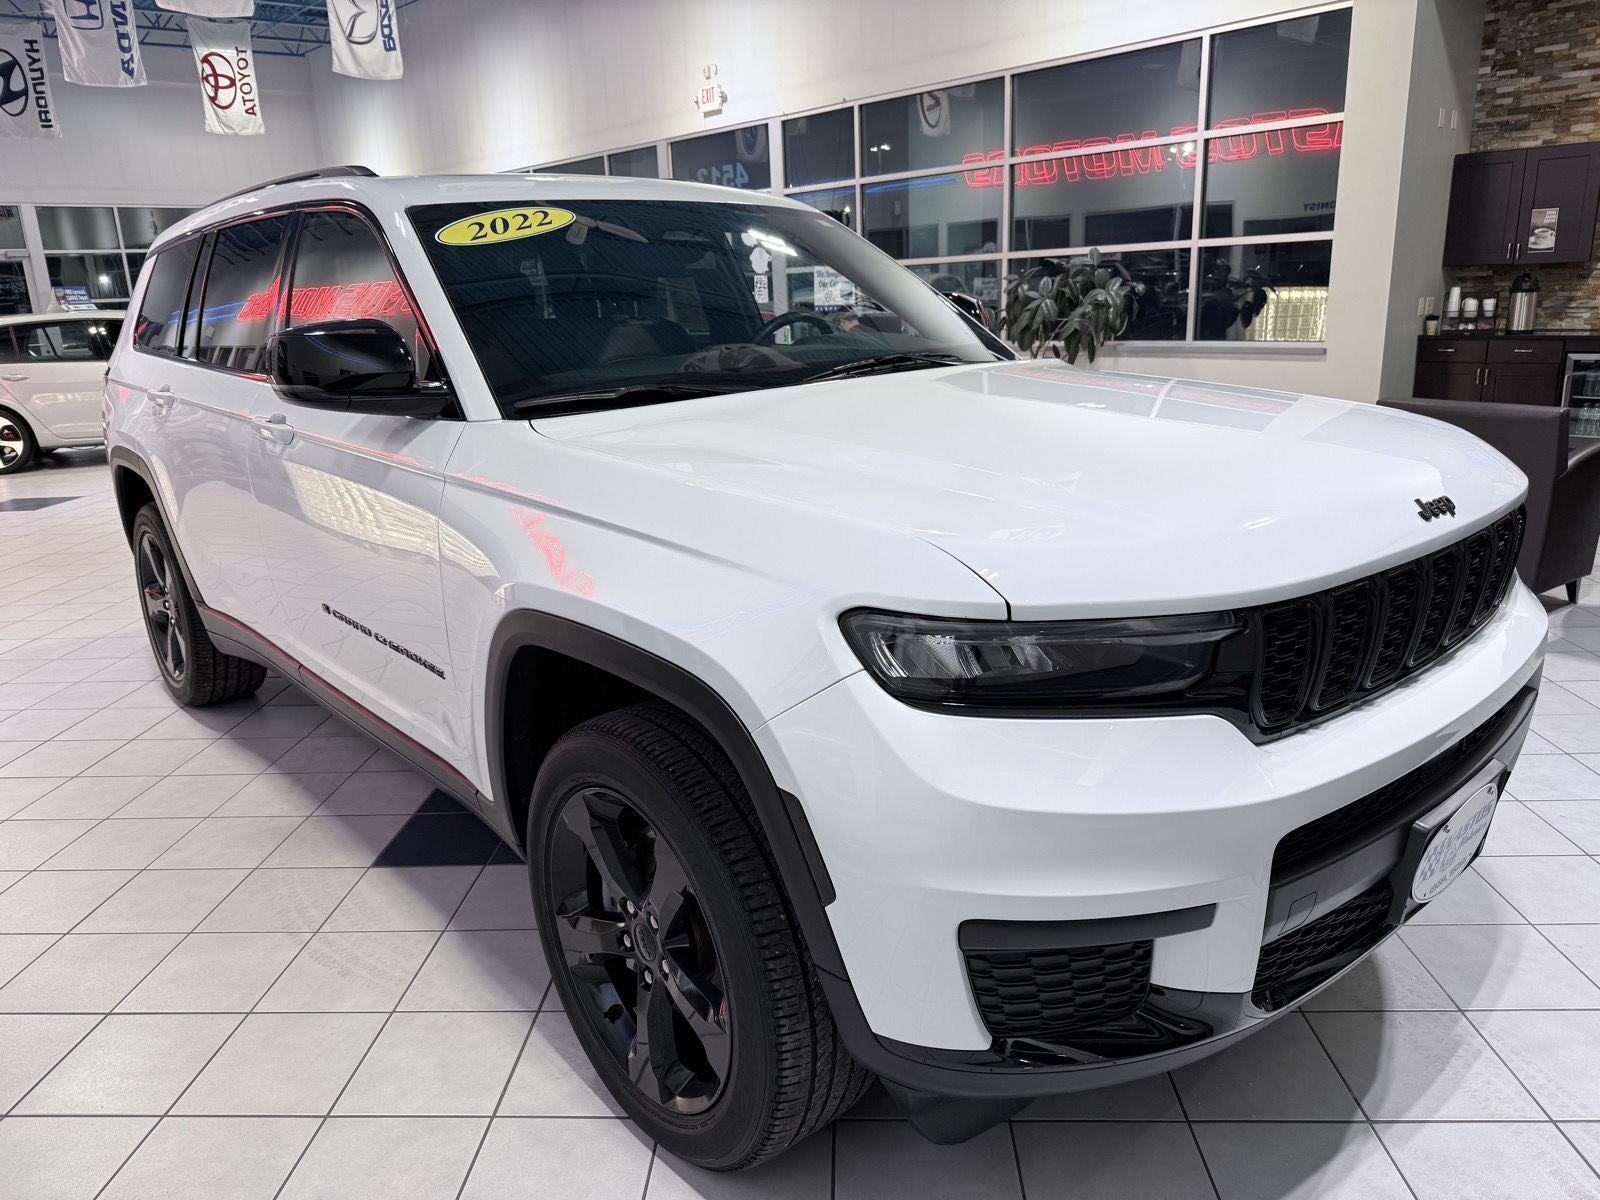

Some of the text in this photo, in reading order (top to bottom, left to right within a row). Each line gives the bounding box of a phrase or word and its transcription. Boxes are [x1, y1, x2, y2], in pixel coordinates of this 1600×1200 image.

[701, 86, 715, 105] EXIT
[467, 209, 553, 242] 2022
[1414, 495, 1456, 522] Jeep
